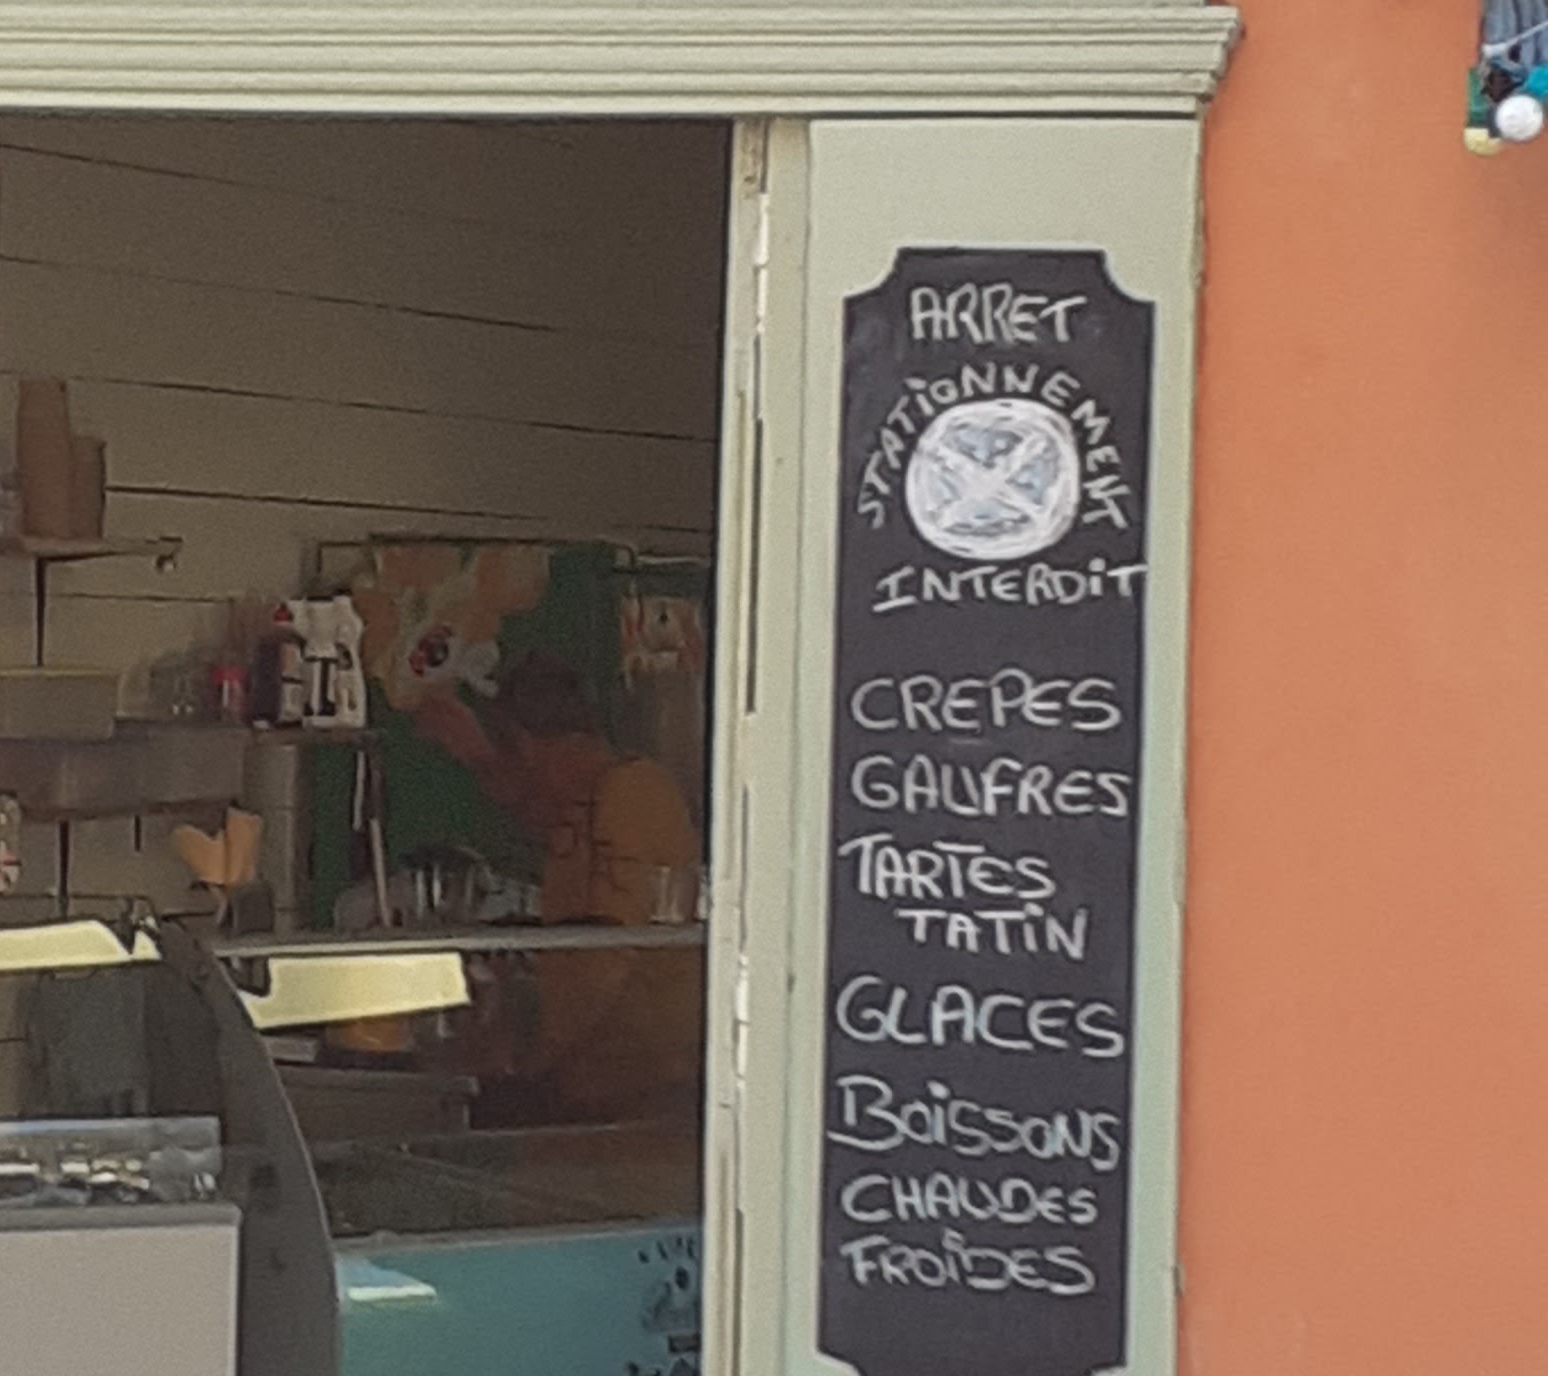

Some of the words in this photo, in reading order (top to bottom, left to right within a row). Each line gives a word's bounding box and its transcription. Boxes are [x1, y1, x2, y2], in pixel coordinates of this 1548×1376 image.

[909, 283, 1088, 344] ARRET
[851, 668, 1123, 734] CREPES
[851, 755, 1132, 817] GAUFRES
[838, 833, 1057, 899] TARTES
[835, 975, 1125, 1059] GLACES
[840, 1172, 1099, 1225] CHAUDES
